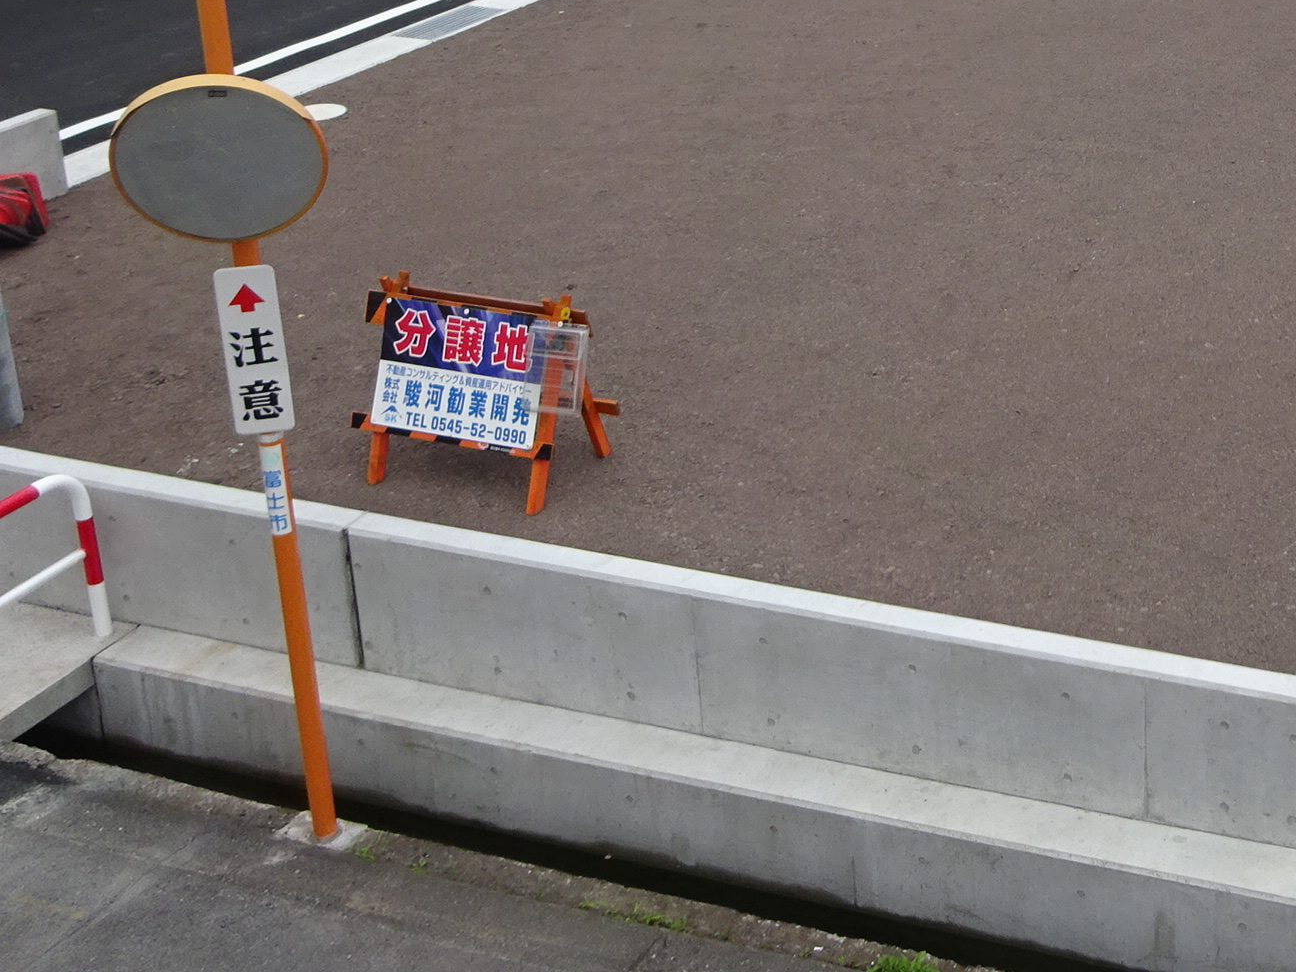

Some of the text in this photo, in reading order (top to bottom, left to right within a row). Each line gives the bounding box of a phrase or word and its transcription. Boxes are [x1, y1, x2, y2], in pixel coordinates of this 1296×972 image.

[393, 308, 535, 373] 分譲地
[228, 327, 284, 422] 注意
[403, 379, 532, 426] 駿河勧業開発
[405, 412, 527, 445] TEL 0545-52-0990
[263, 470, 288, 532] 富士市
